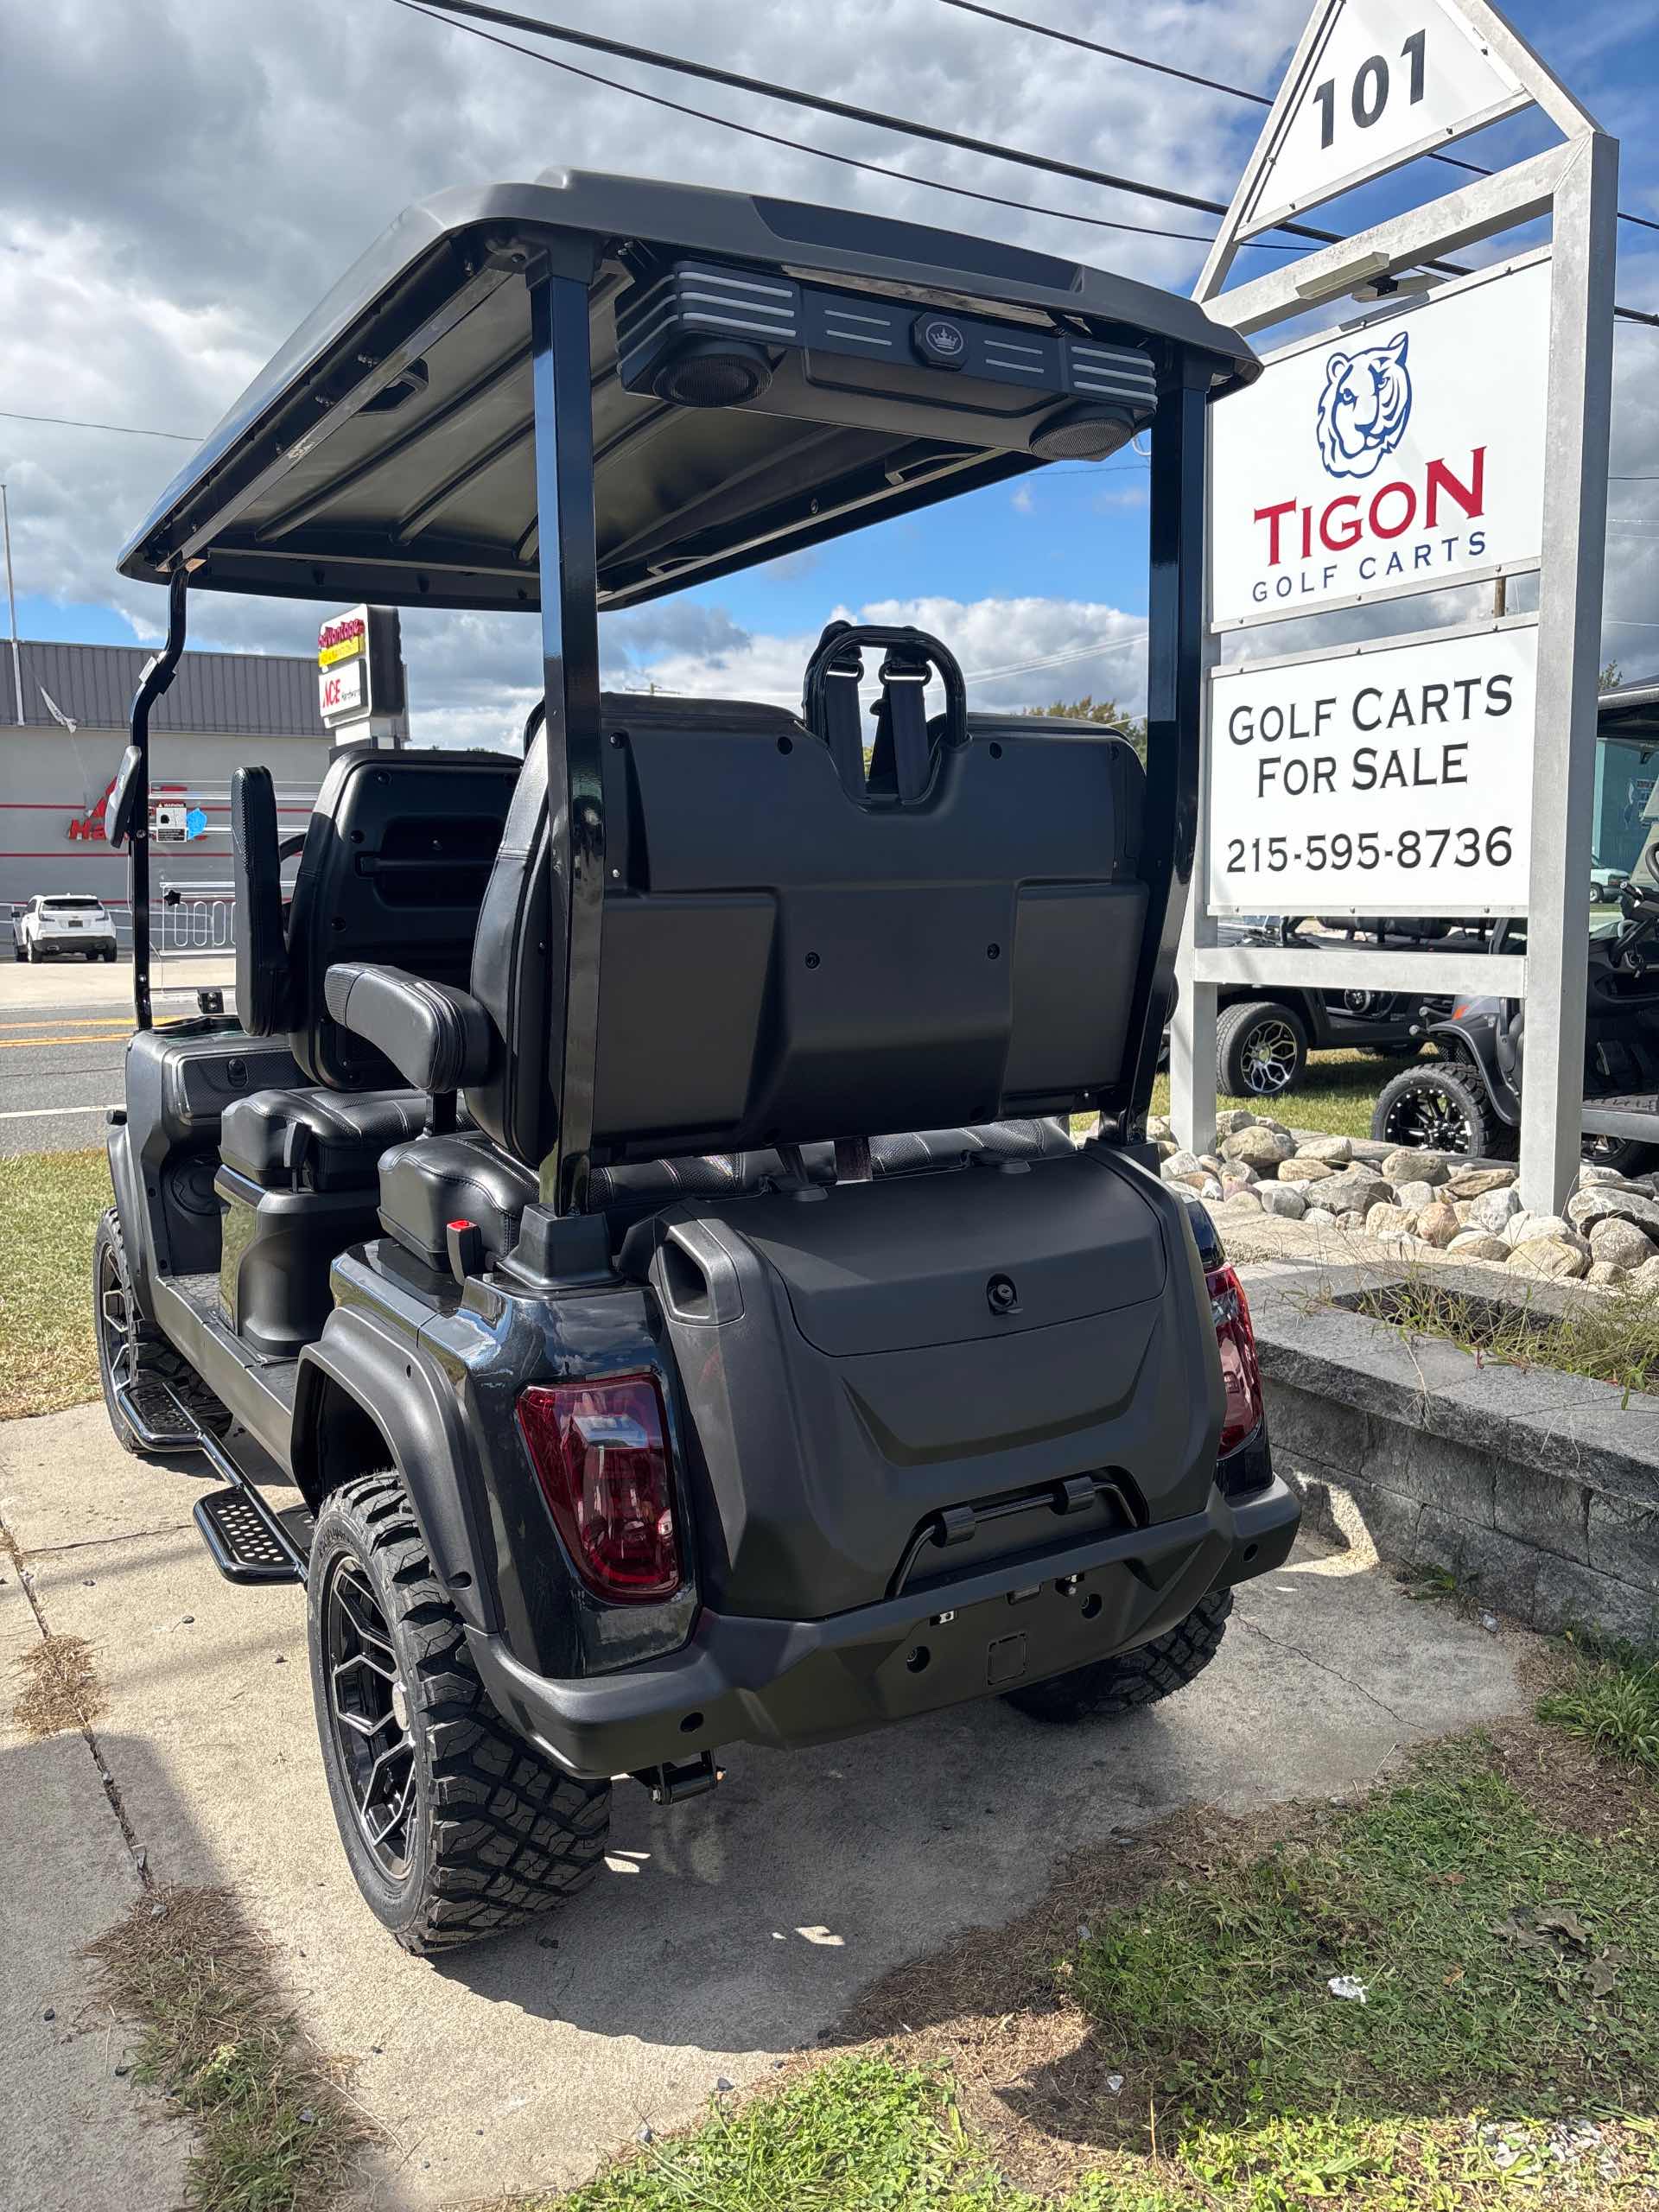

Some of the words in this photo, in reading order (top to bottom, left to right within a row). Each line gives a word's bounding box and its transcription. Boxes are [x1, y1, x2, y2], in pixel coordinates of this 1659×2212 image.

[1313, 29, 1426, 149] 101
[1254, 446, 1487, 567] TIGON
[1252, 564, 1338, 603] GOLF
[1359, 531, 1486, 580] CARTS
[323, 678, 340, 708] ACE
[1229, 697, 1338, 746] GOLF
[1351, 674, 1513, 732] CARTS
[1258, 756, 1337, 798] FOR
[1351, 742, 1468, 791] SALE
[1226, 825, 1513, 873] 215-595-8736
